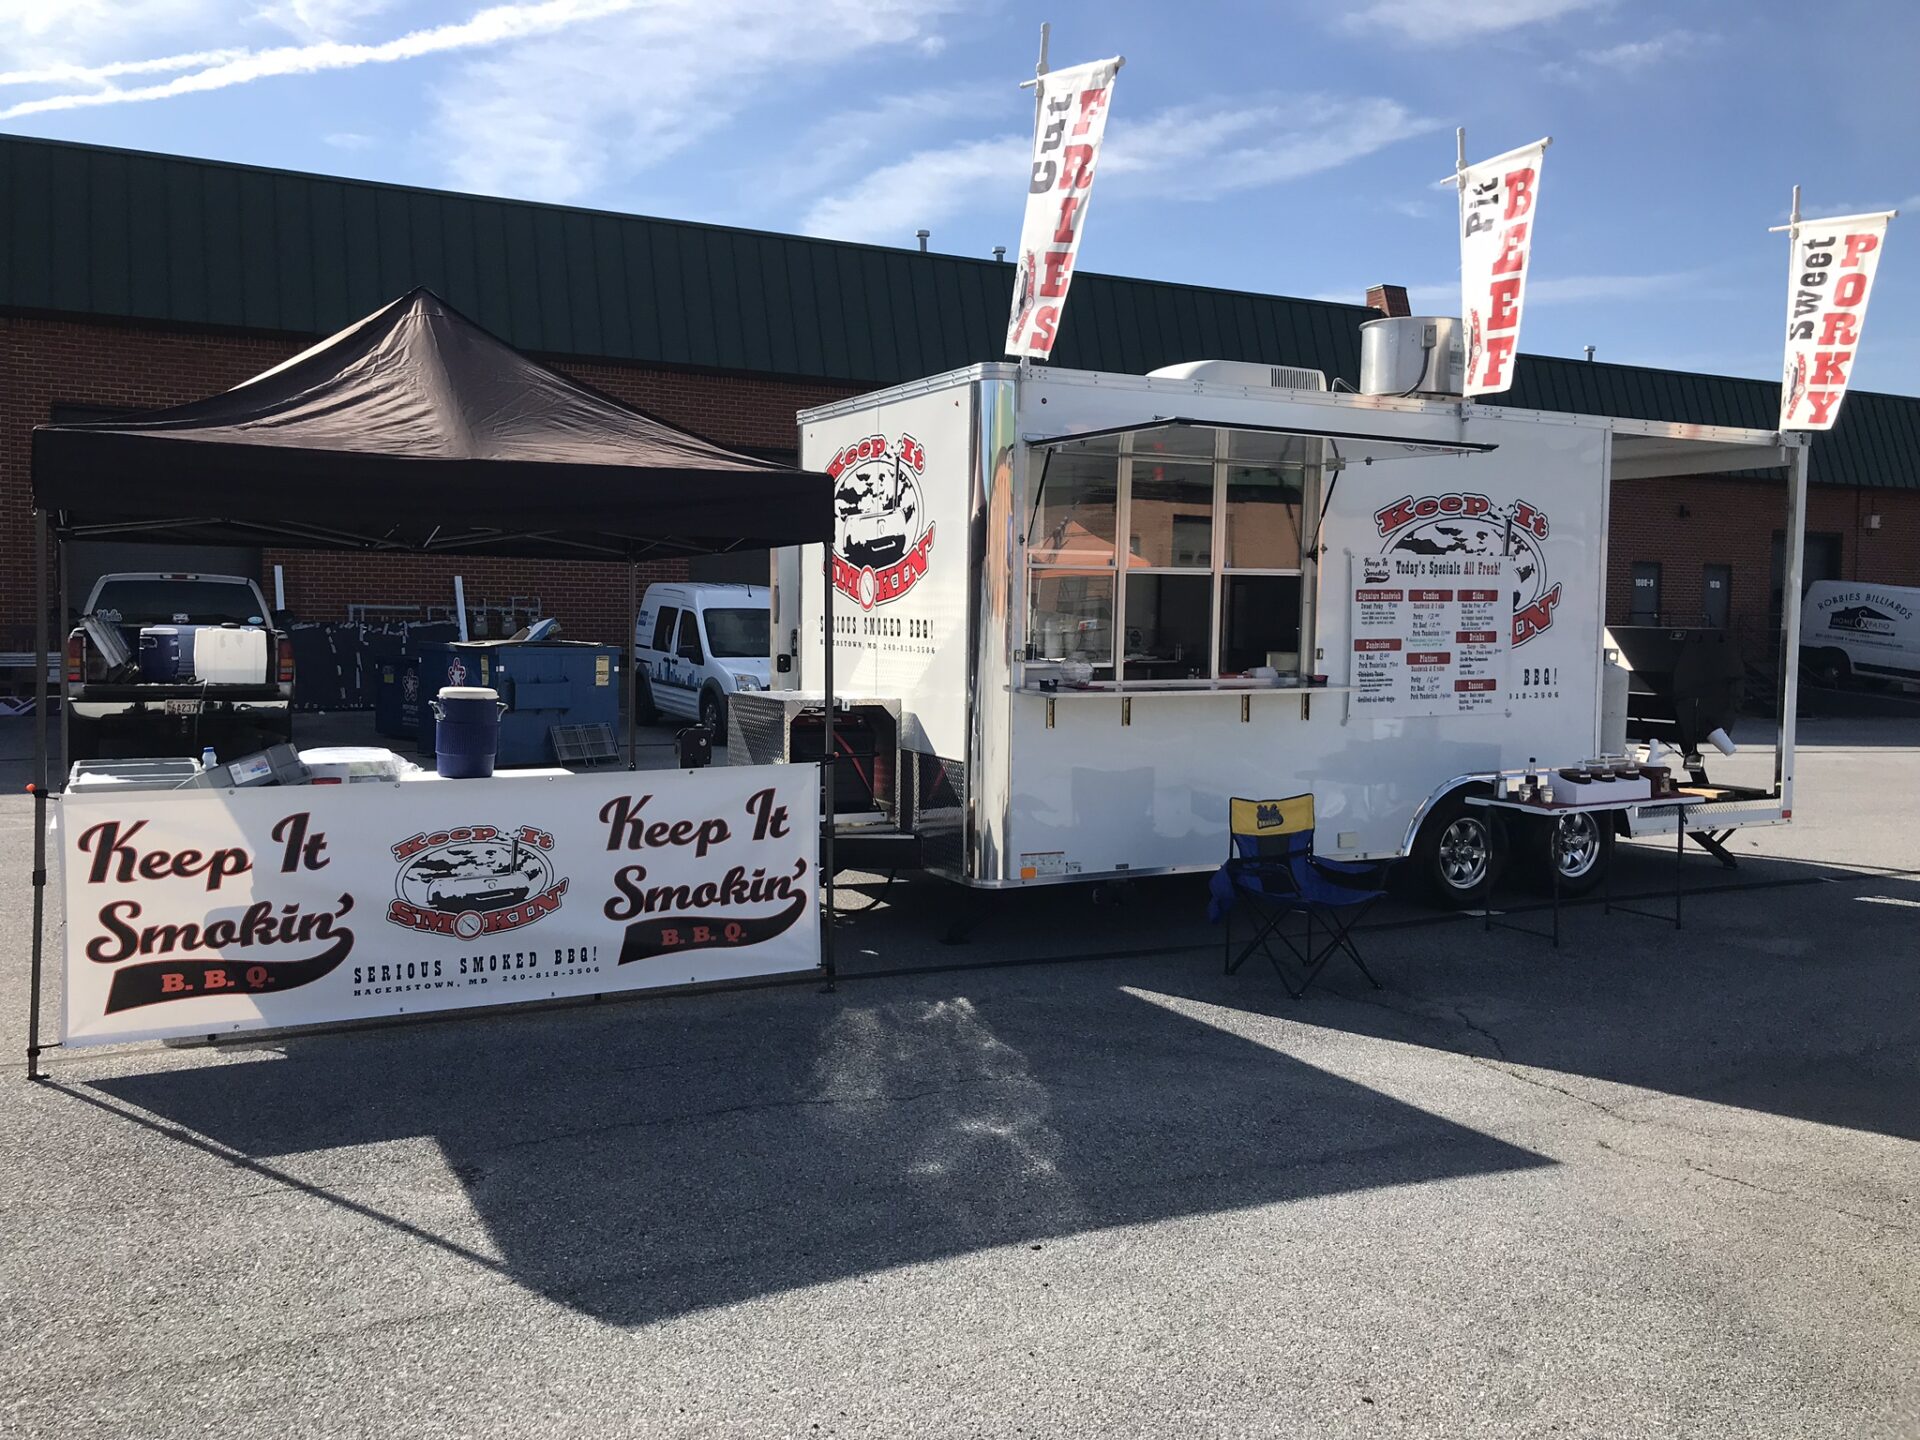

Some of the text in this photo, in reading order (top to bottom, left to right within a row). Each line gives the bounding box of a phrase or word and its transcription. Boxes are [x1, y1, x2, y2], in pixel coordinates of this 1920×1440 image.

[1029, 92, 1073, 194] Cut
[1029, 87, 1107, 352] FRIES
[1465, 176, 1499, 239] Pit
[1482, 167, 1535, 387] BEEF
[1807, 233, 1878, 424] PORKY
[827, 433, 925, 480] Keep It
[1374, 493, 1550, 541] Keep It
[1364, 557, 1380, 568] Keep
[1396, 560, 1501, 577] Today's Specials All Fresh!
[1358, 592, 1380, 601] Signature
[1423, 592, 1439, 600] Combos
[1472, 592, 1485, 600] Sides
[1817, 592, 1914, 621] ROBBIES BILLIARDS
[820, 615, 934, 640] SIOUS SMOKED BBQ!
[1832, 616, 1854, 627] HOME
[1366, 641, 1390, 650] Sandwiches
[1469, 633, 1485, 642] Drinks
[1419, 654, 1438, 663] Platters
[1469, 681, 1484, 690] Sauces
[1524, 668, 1558, 686] BBQ!
[599, 787, 791, 859] Keep It
[77, 812, 331, 892] Keep It
[391, 825, 555, 862] Keep It
[603, 857, 808, 921] Smokin'
[85, 892, 355, 964] Smokin'
[354, 946, 598, 985] SERIOUS SMOKED BBQ!
[353, 966, 601, 997] HAGERSTOWN, MD 240-818-3506
